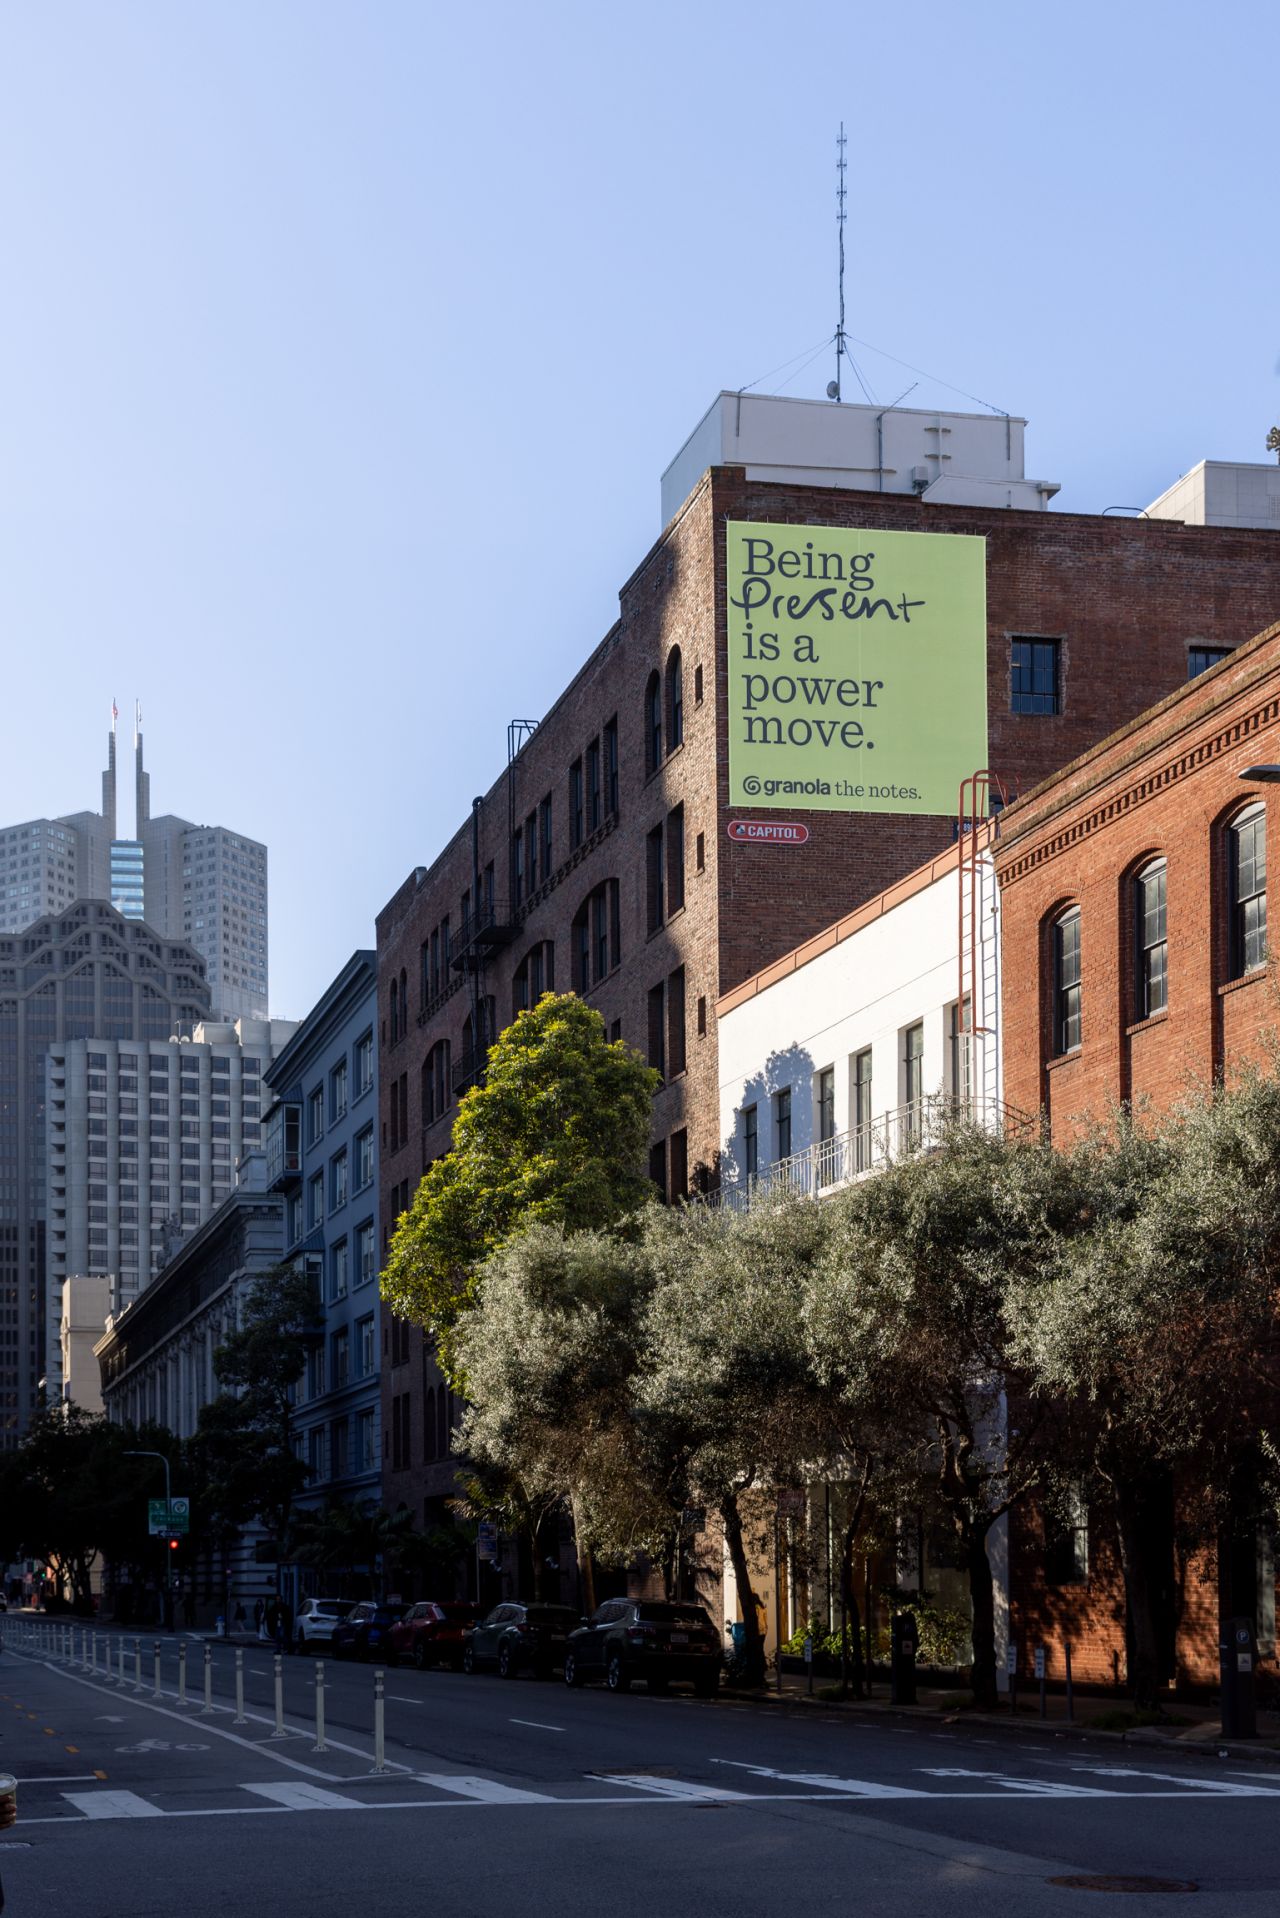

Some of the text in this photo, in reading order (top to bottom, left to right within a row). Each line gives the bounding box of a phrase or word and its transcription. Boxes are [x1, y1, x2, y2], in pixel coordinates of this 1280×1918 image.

[742, 538, 875, 591] Being
[730, 577, 926, 623] Present
[742, 623, 819, 663] is a
[742, 675, 884, 710] power
[743, 717, 875, 750] move.
[763, 778, 922, 800] granola the notes.
[748, 825, 800, 839] CAPITOL
